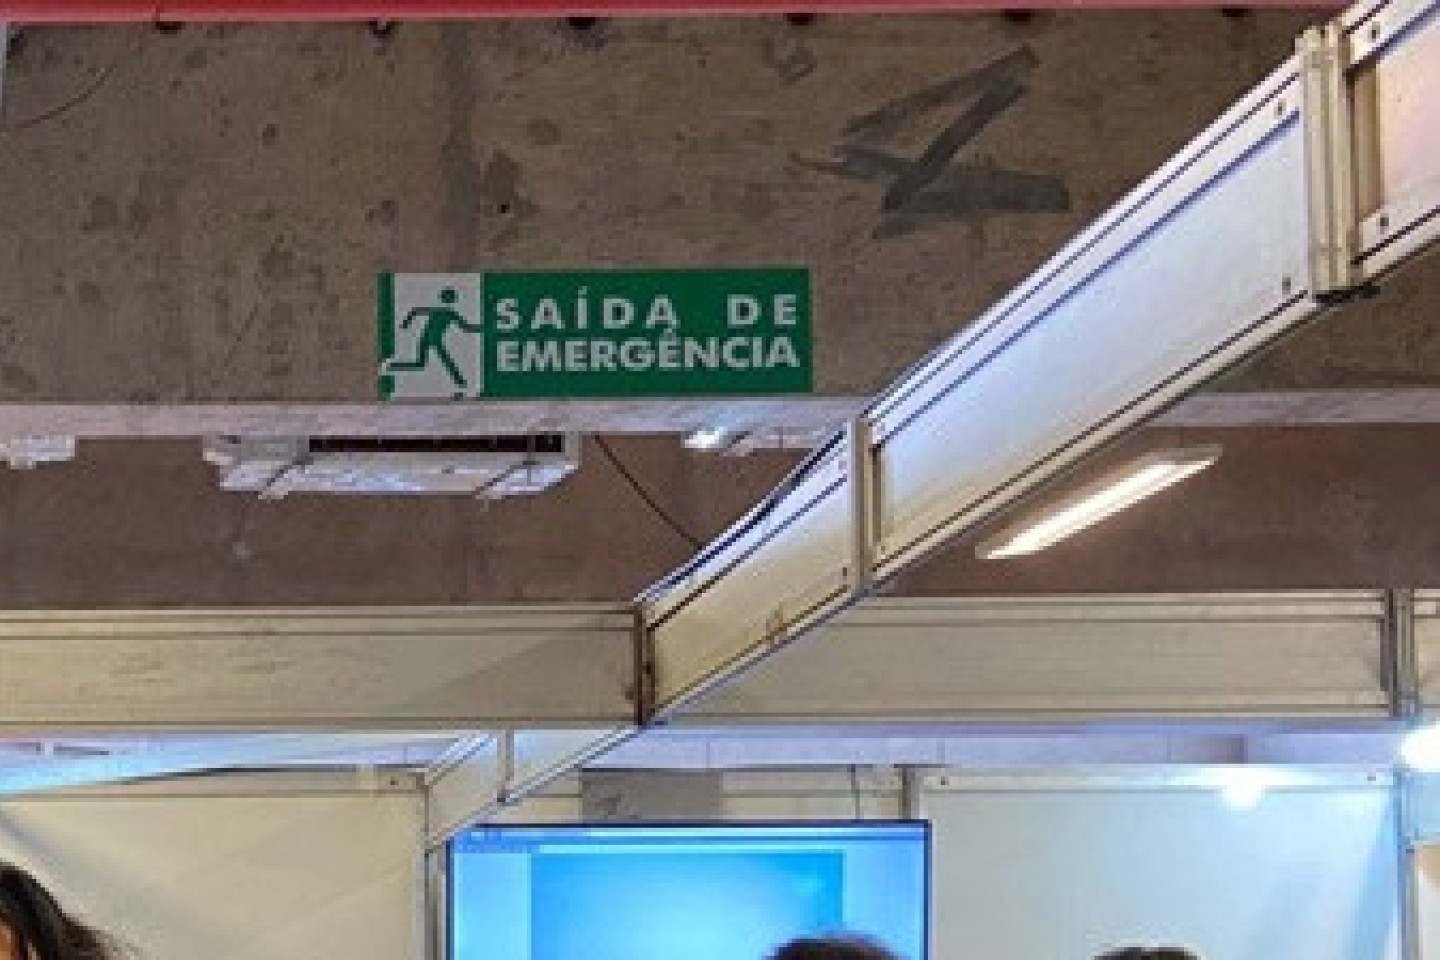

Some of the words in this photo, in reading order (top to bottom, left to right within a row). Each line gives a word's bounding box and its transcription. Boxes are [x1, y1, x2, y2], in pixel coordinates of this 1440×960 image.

[496, 286, 679, 329] SAÍDA
[727, 294, 798, 326] DE
[496, 328, 801, 372] EMERGÊNCIA
